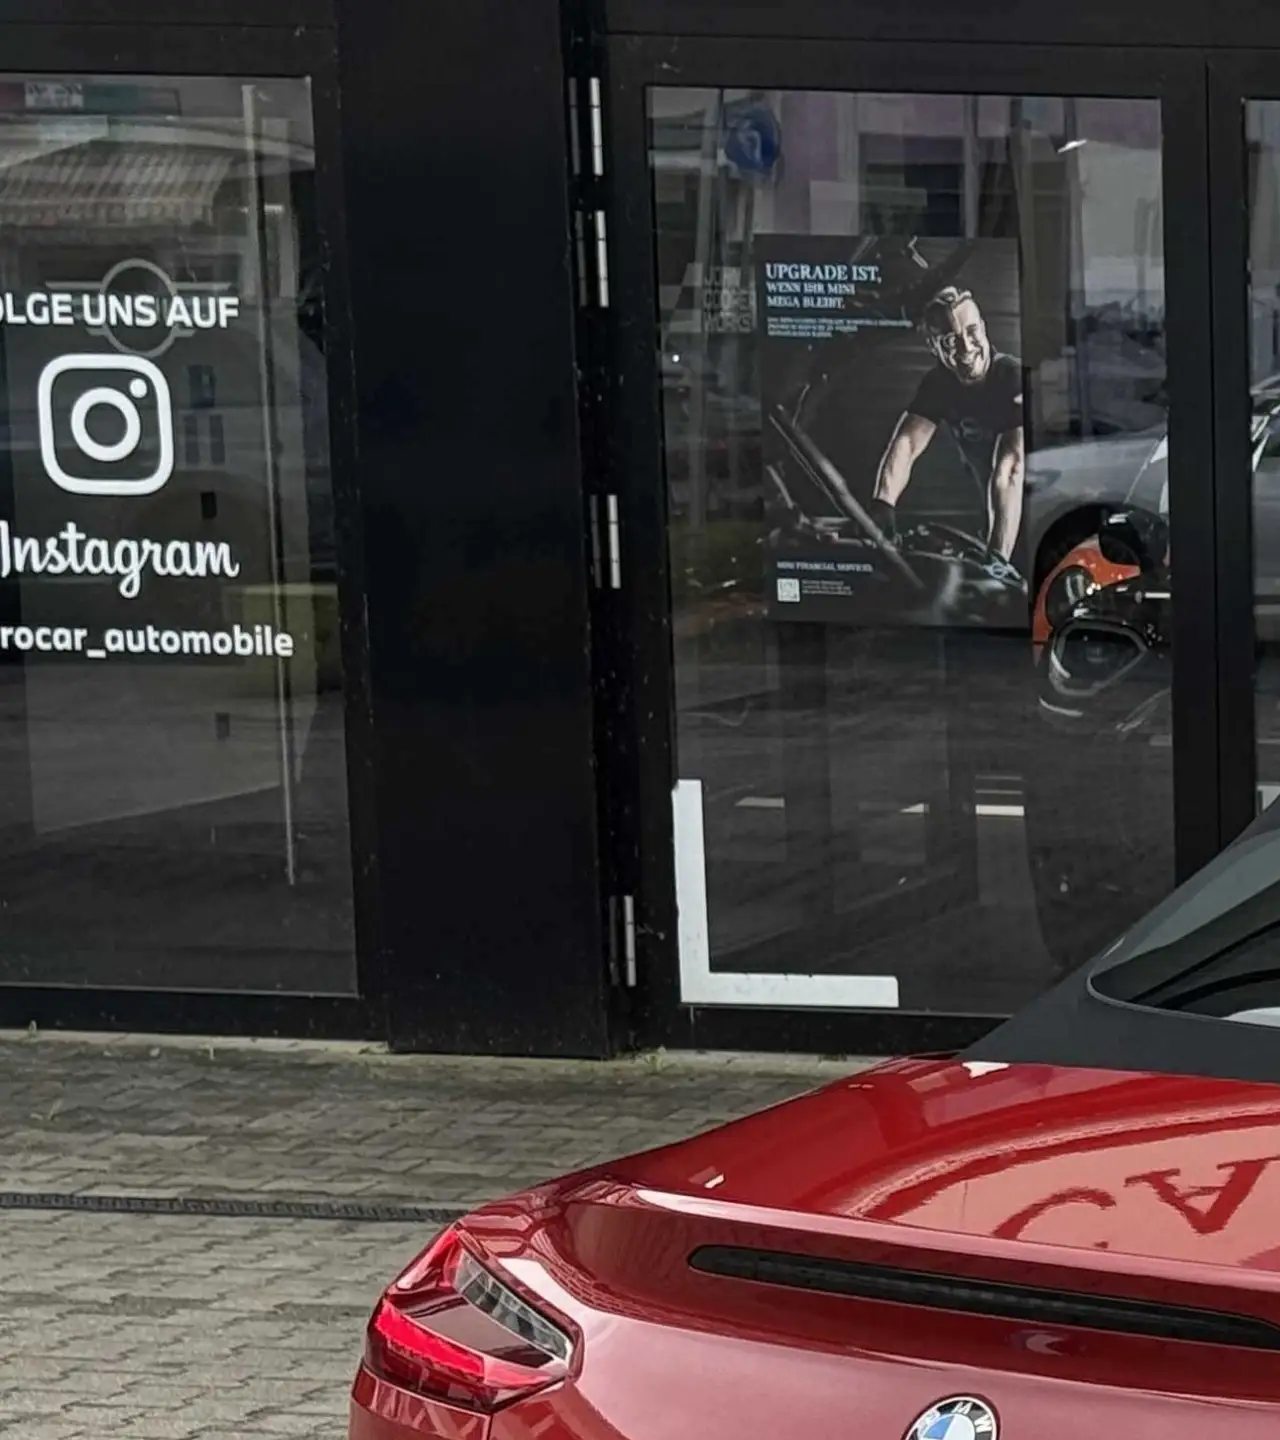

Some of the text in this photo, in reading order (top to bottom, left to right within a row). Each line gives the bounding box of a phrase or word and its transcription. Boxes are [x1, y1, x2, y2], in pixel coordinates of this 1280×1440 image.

[765, 262, 882, 284] UPGRADE IST,
[766, 281, 855, 295] WENN IHR MINI
[0, 292, 239, 328] LGE UNS AUF
[767, 295, 800, 308] MEGA
[0, 520, 240, 598] Instagram
